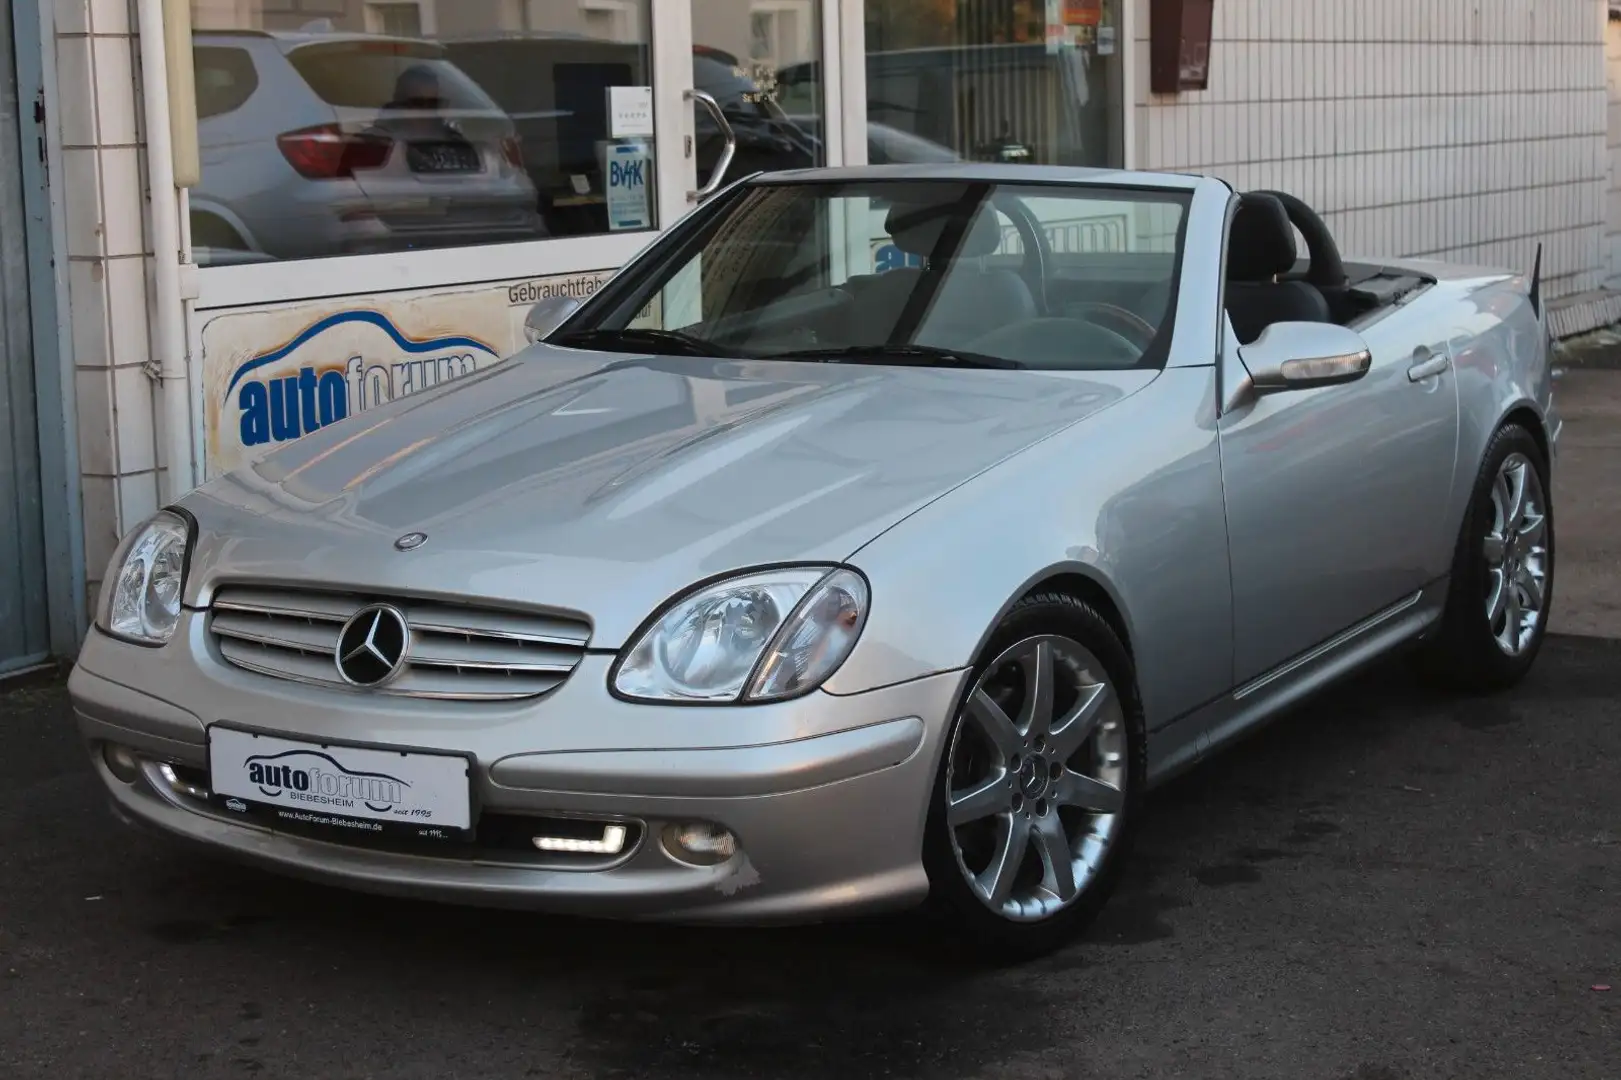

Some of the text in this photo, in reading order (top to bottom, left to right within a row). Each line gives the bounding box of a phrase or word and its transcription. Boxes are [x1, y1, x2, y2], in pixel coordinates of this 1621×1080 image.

[508, 275, 609, 303] Gebrauchtfah
[249, 762, 401, 804] autoforum
[290, 791, 354, 808] BIEBESHEIM
[278, 811, 383, 831] www.AutoForum-Biebesheim.de
[410, 809, 432, 818] 1995
